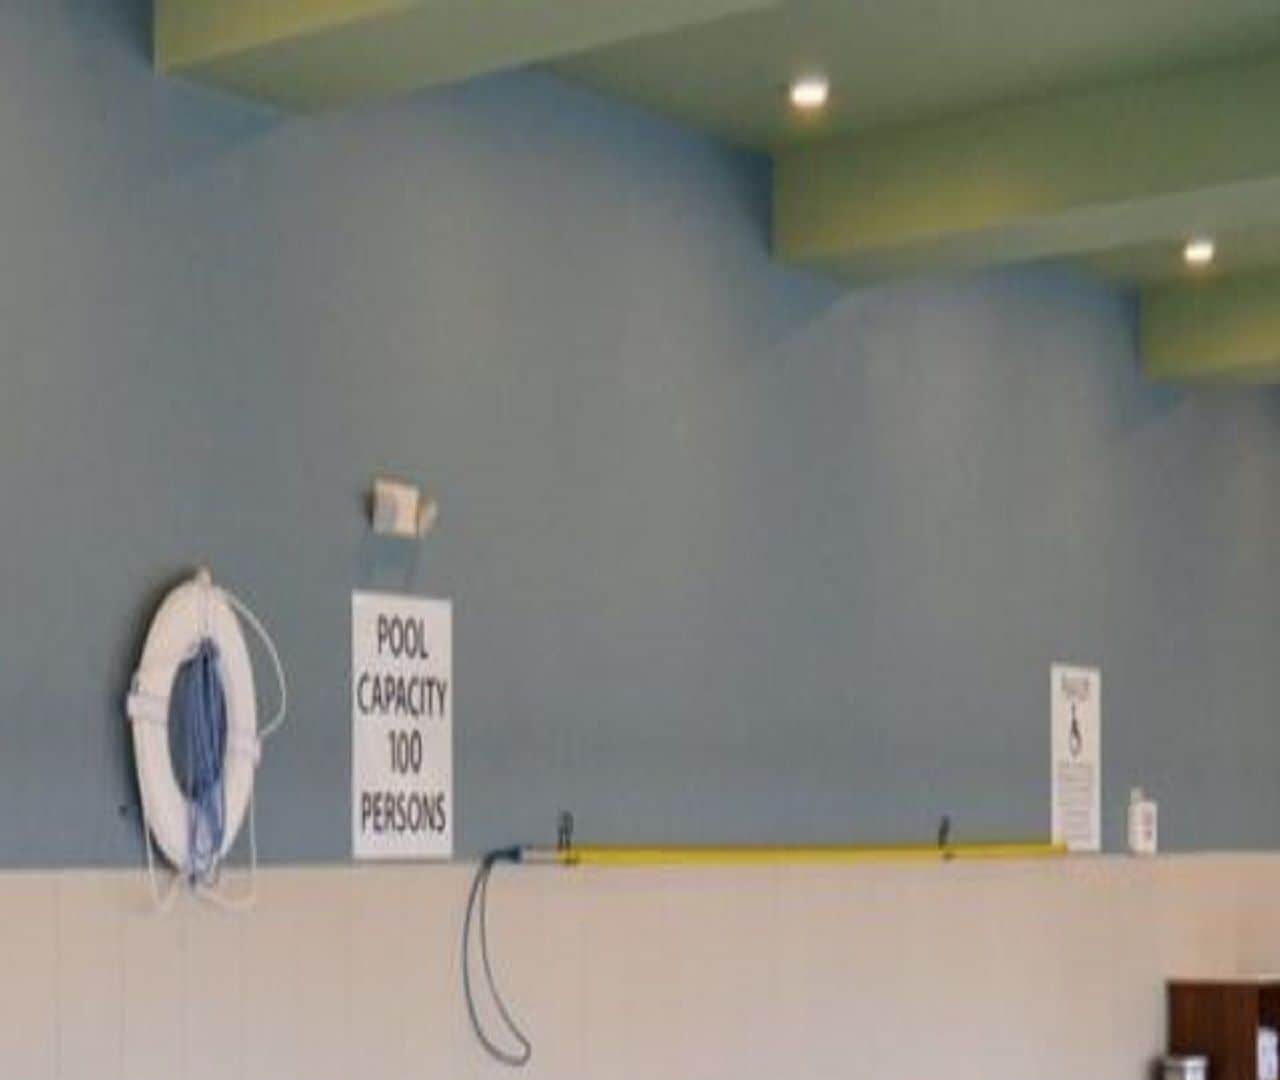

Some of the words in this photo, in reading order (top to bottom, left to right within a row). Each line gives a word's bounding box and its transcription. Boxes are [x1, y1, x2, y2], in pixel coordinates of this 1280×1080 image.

[377, 613, 428, 660] POOL
[356, 671, 447, 718] CAPACITY
[388, 728, 422, 775] 100
[360, 791, 447, 834] PERSONS
